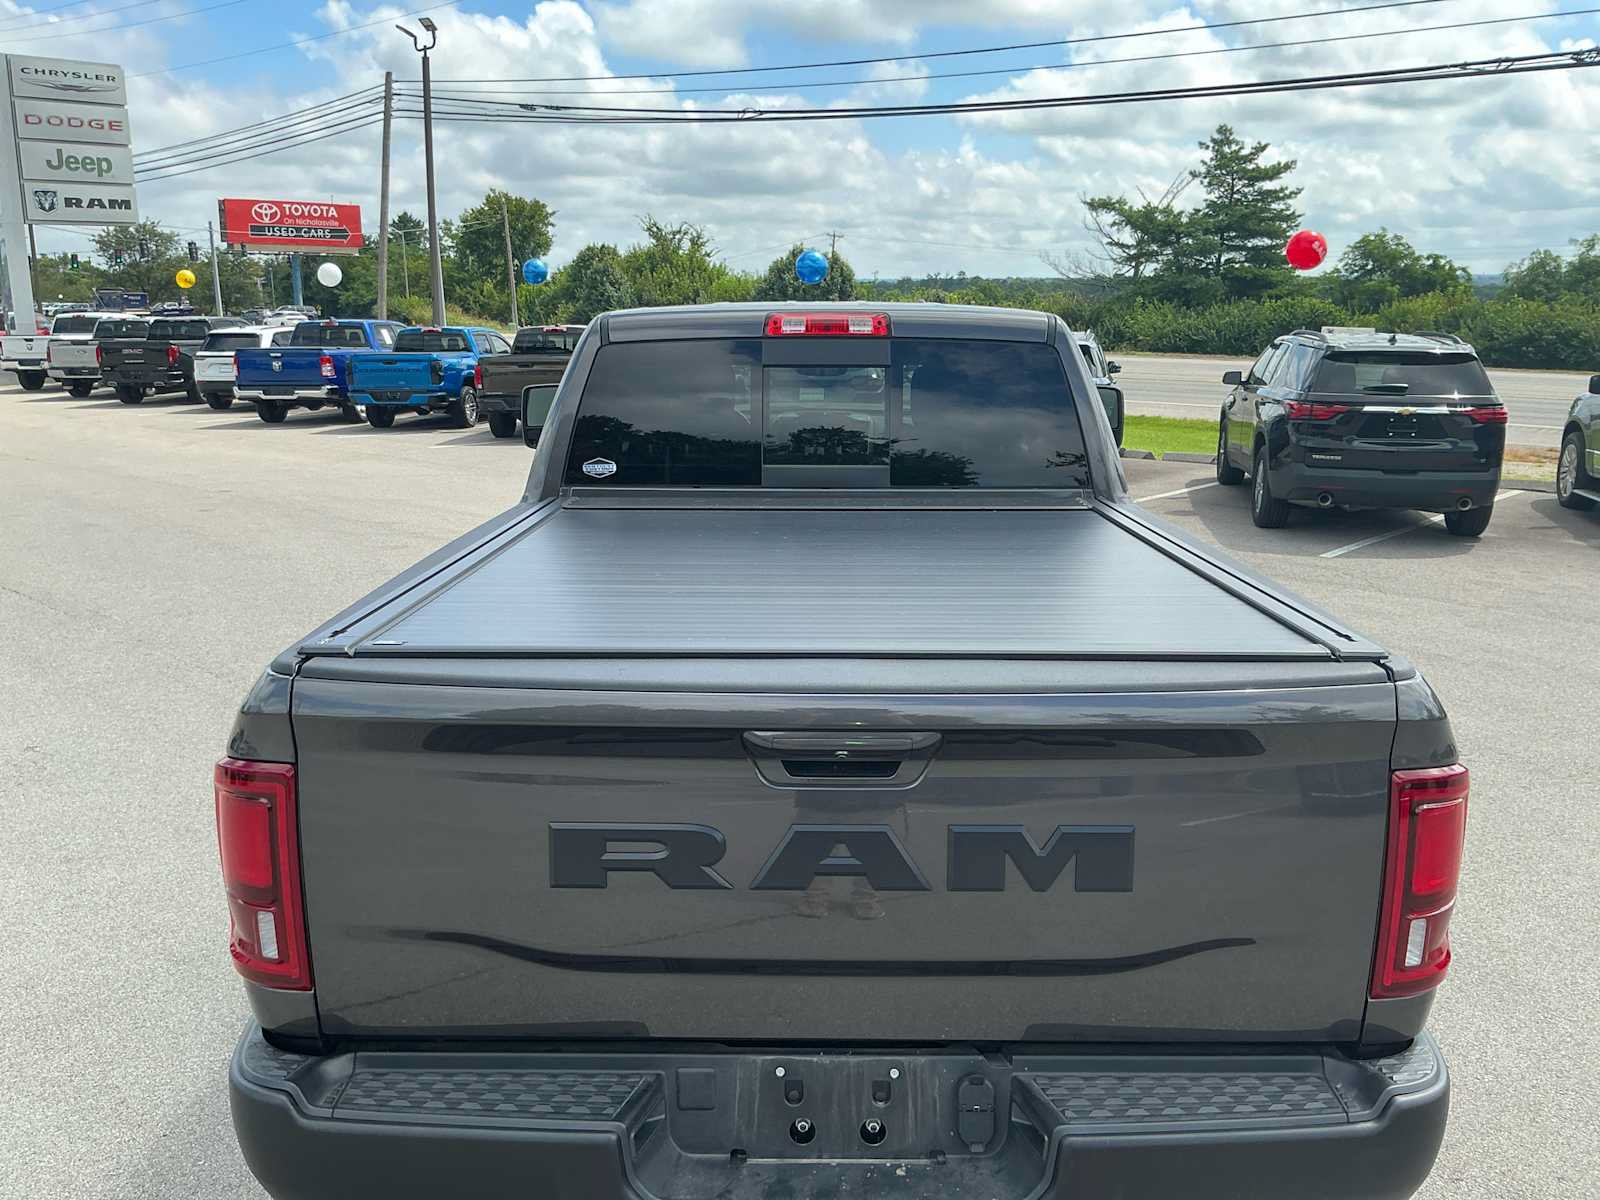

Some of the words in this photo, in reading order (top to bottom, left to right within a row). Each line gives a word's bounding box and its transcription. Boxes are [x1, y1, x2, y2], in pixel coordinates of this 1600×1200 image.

[20, 67, 117, 82] CHRYSLER
[24, 113, 124, 132] DODGE
[46, 148, 113, 177] Jeep
[63, 197, 132, 210] RAM
[282, 203, 338, 218] TOYOTA
[283, 217, 295, 225] On
[296, 217, 340, 227] Nicholasville
[264, 226, 297, 237] USED
[301, 228, 332, 238] CARS
[548, 821, 1136, 893] RAM
